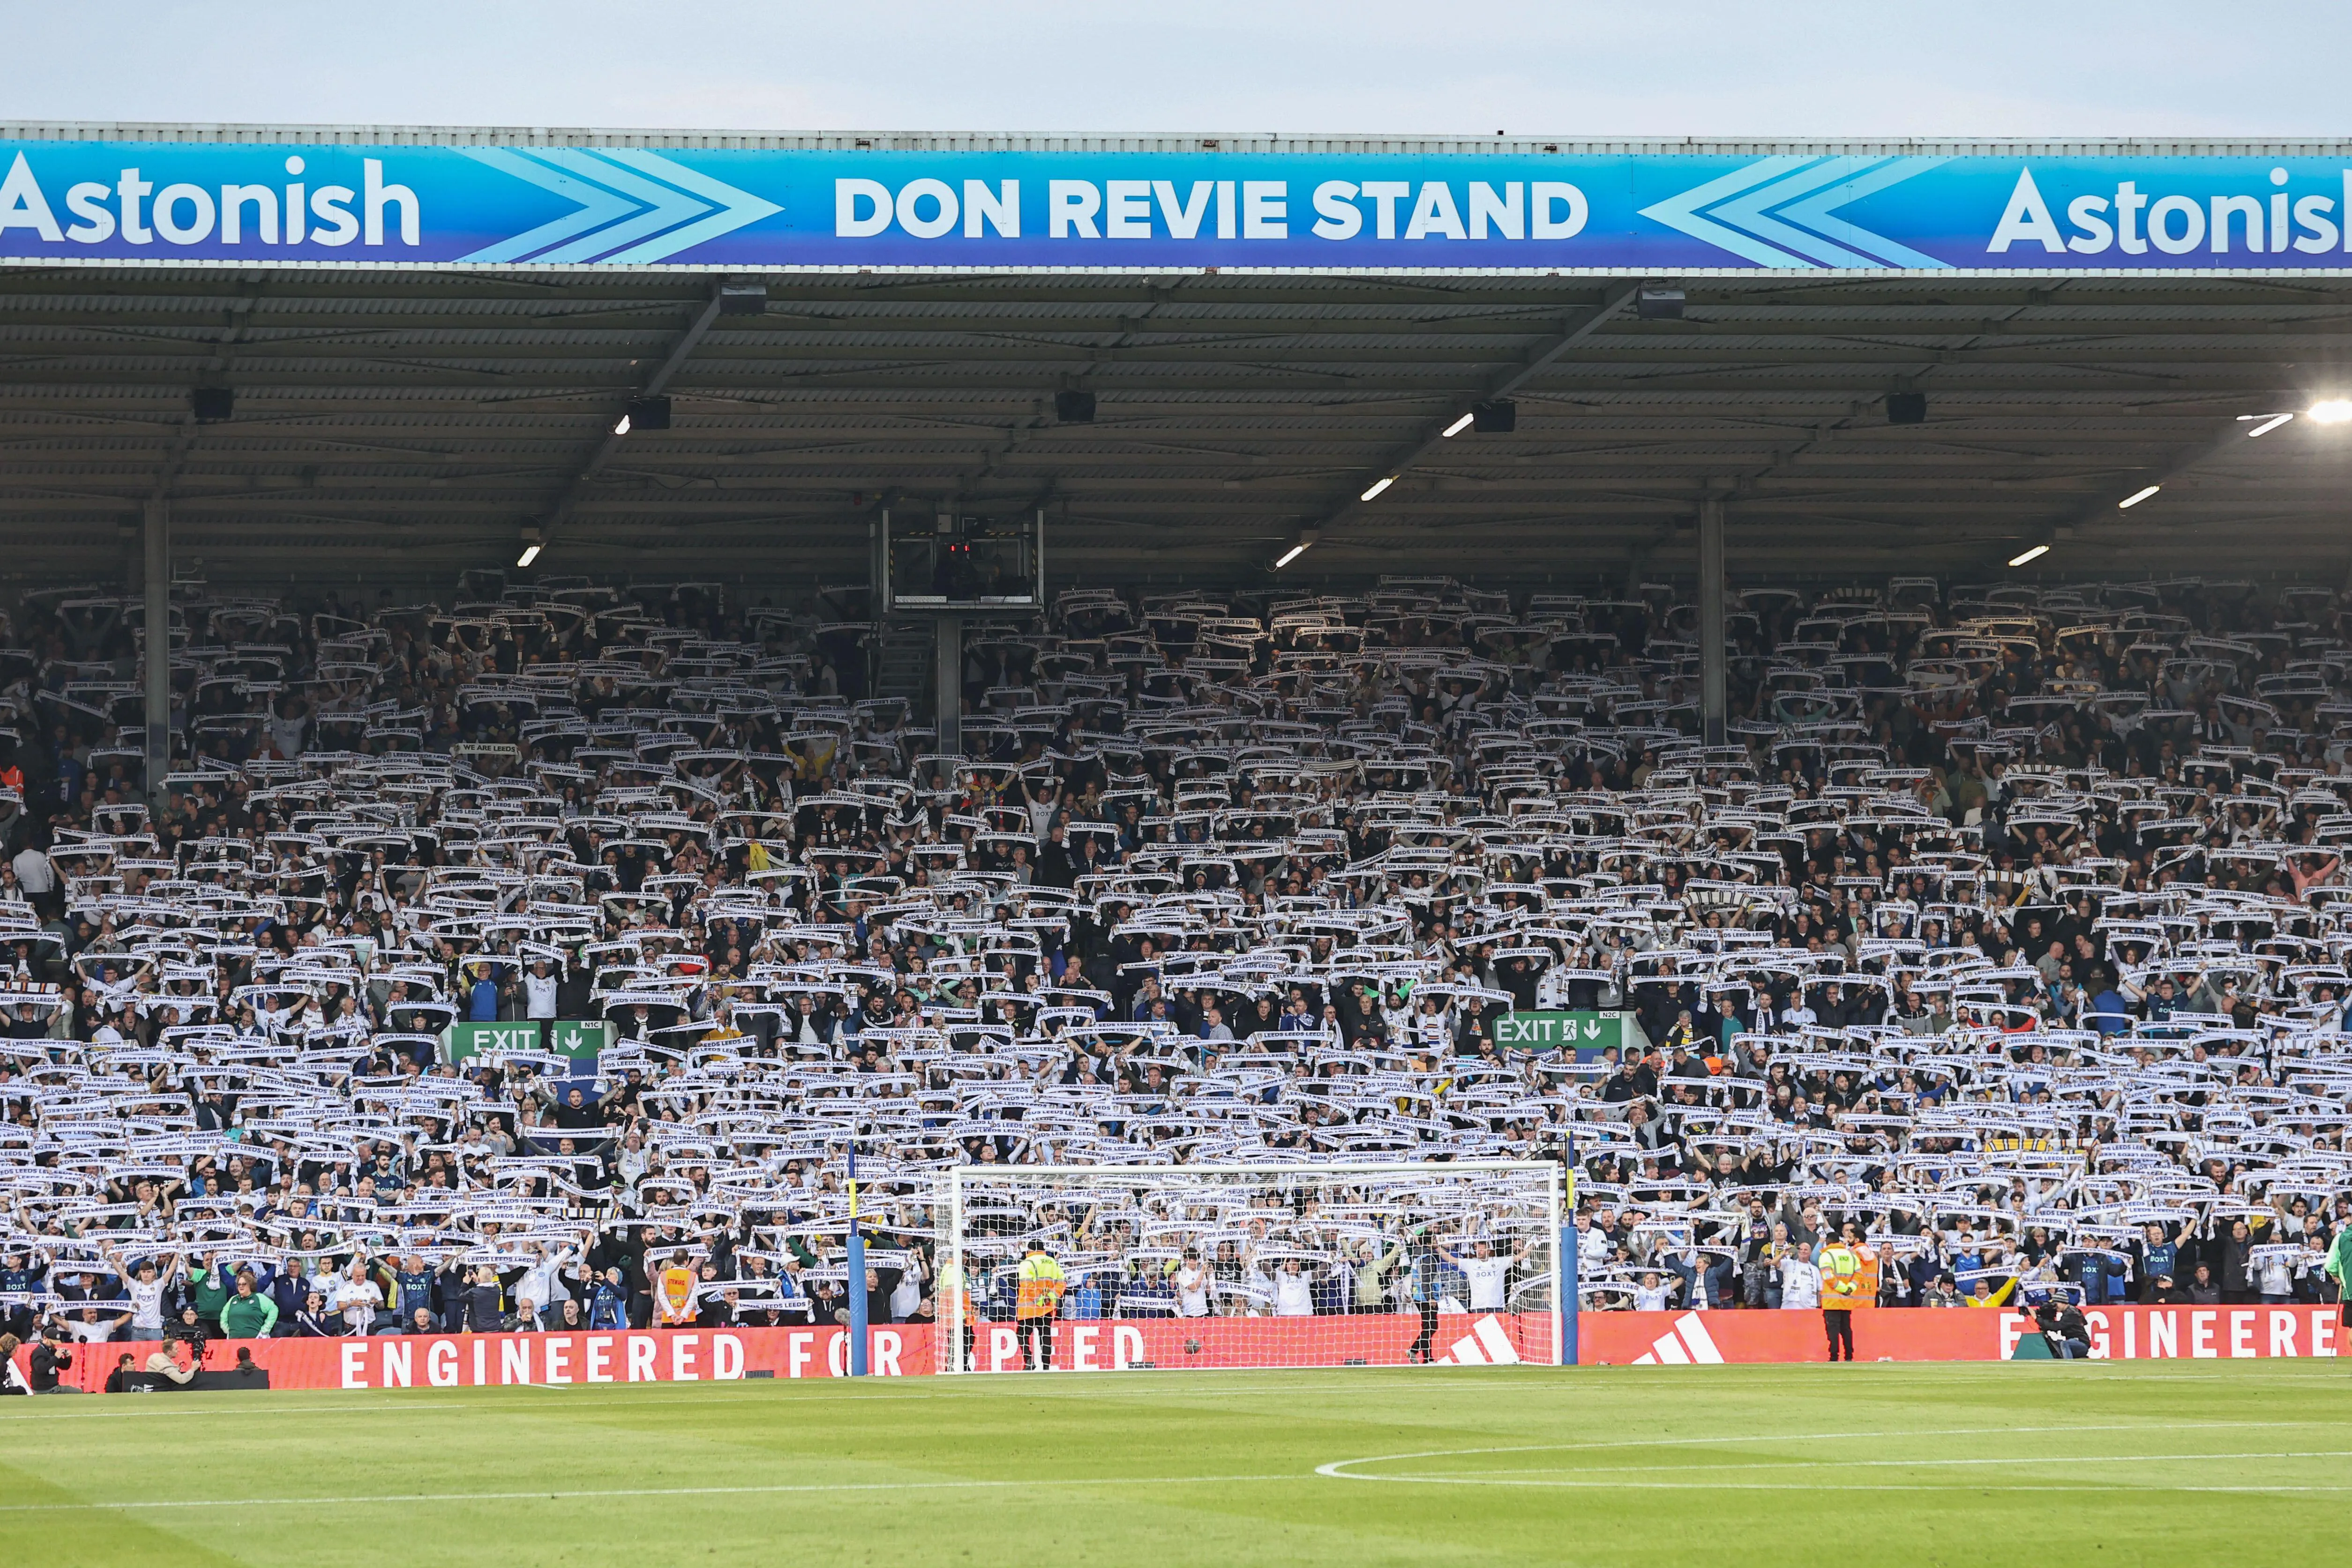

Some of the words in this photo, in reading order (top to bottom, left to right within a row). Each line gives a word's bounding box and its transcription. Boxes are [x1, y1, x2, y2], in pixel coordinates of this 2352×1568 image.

[0, 150, 419, 248] Astonish
[835, 178, 1019, 239] DON
[1049, 179, 1288, 240] REVIE
[1311, 180, 1589, 241] STAND
[474, 1030, 535, 1052] EXIT
[1497, 1020, 1555, 1041] EXIT
[342, 1335, 744, 1388] ENGINEERED
